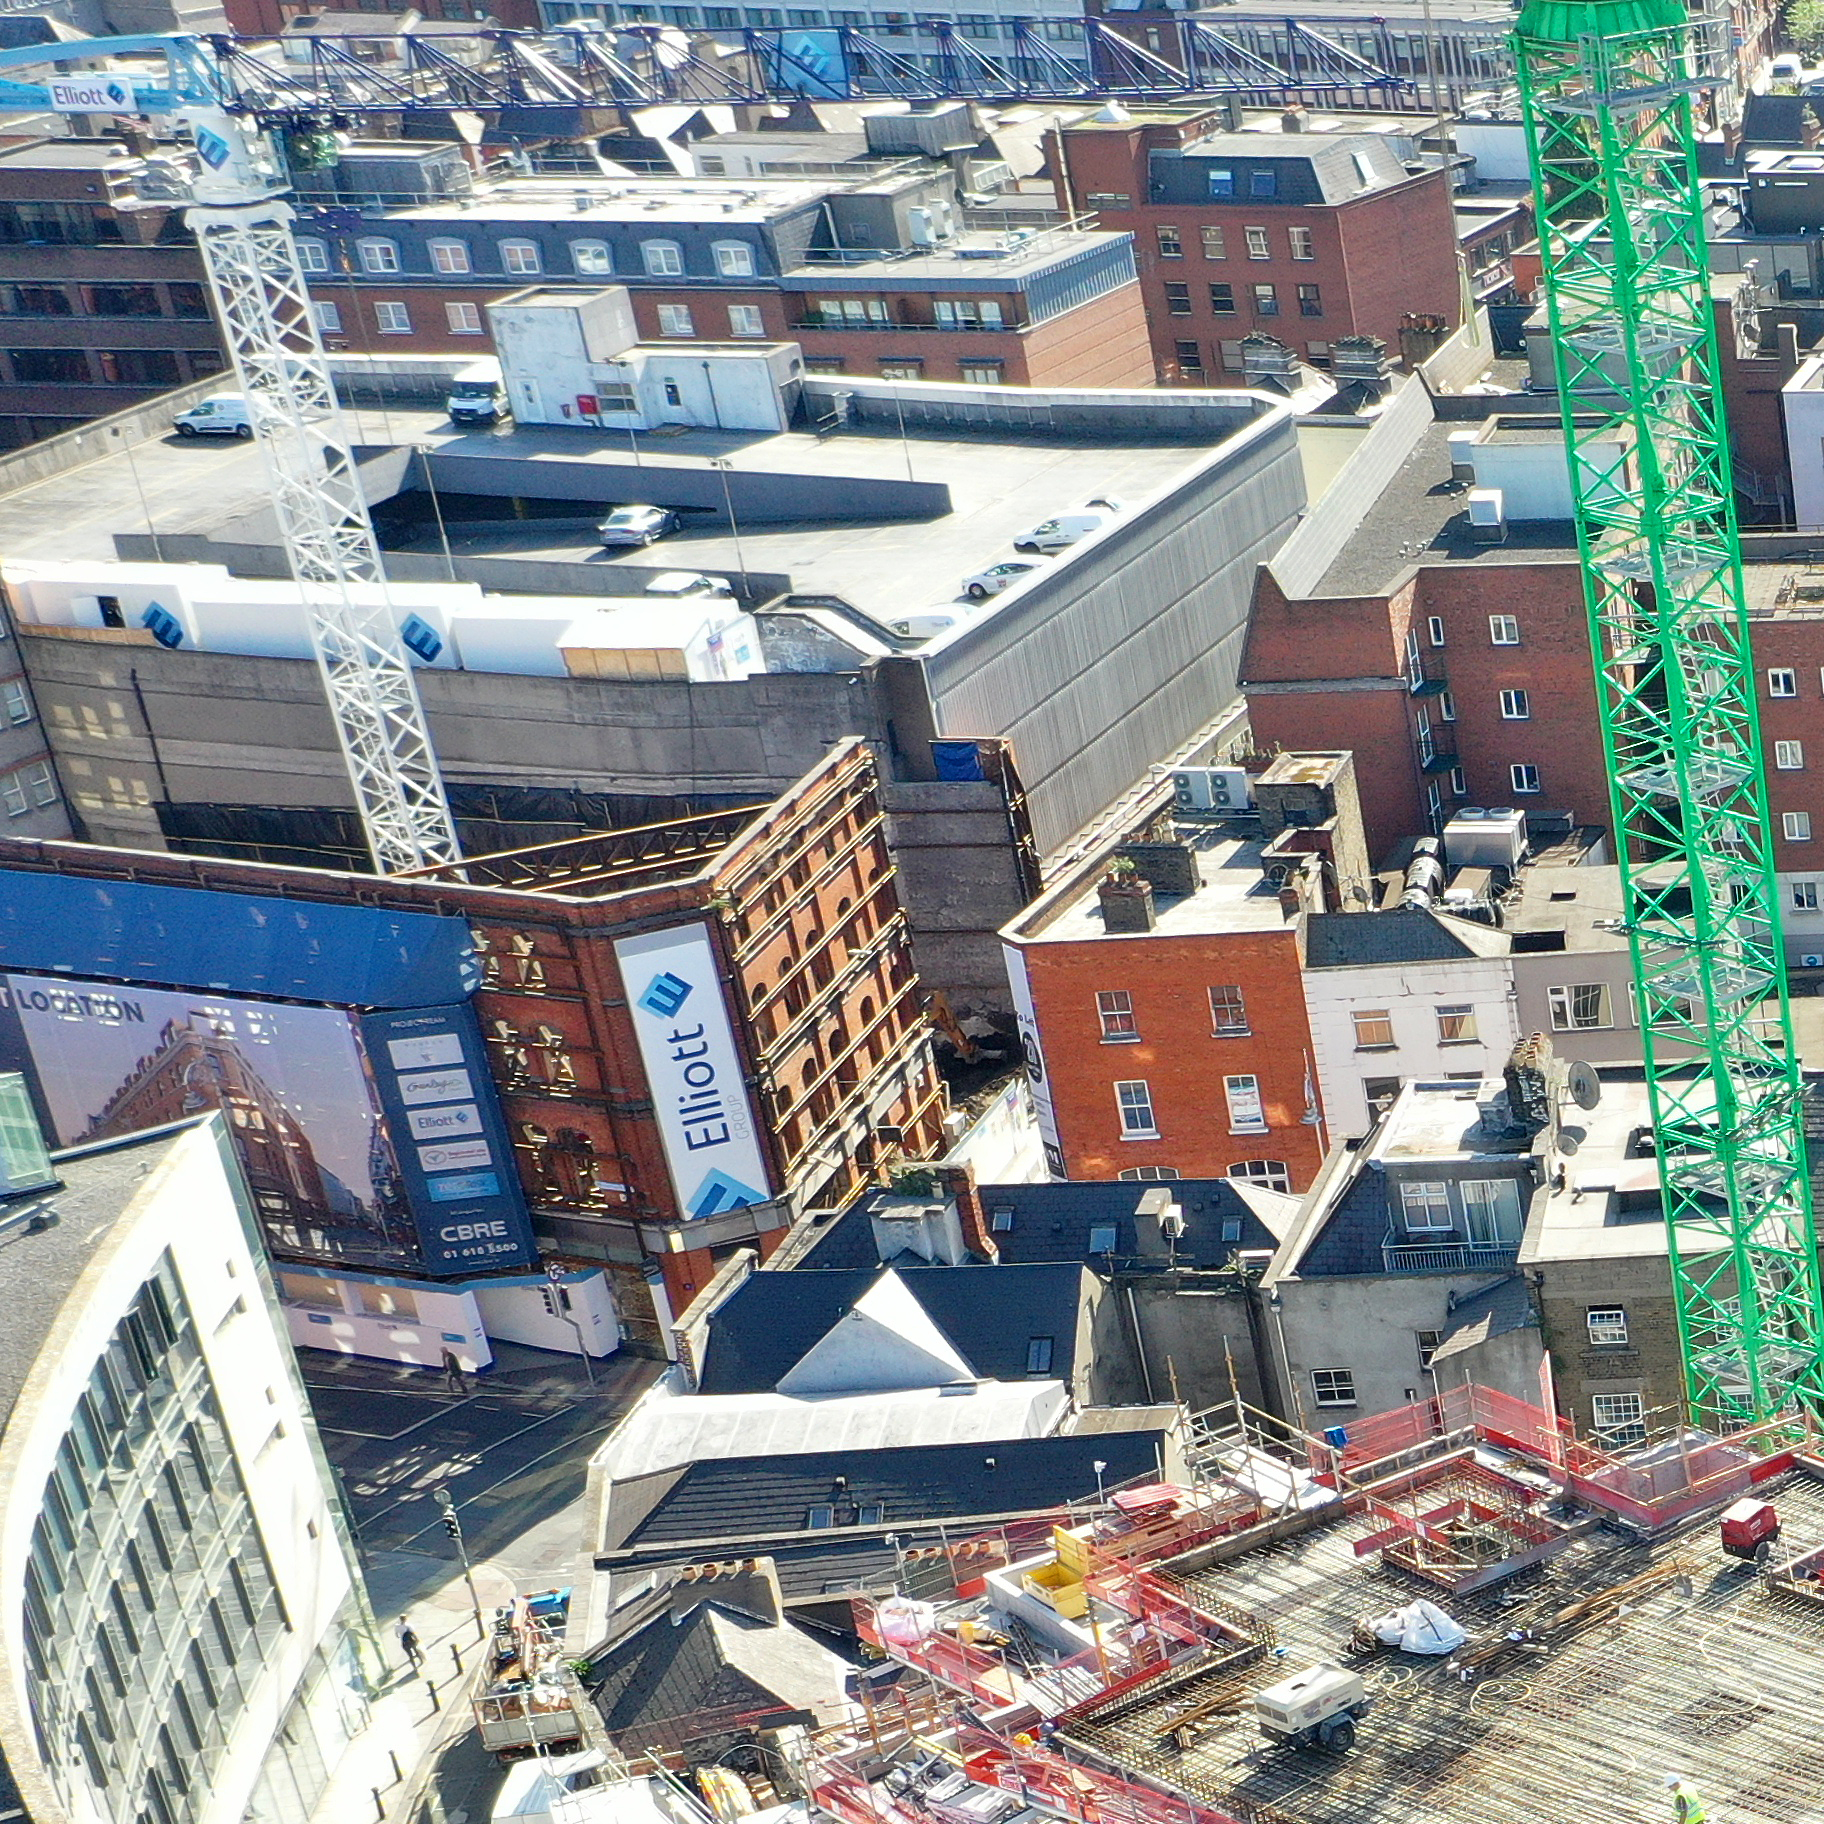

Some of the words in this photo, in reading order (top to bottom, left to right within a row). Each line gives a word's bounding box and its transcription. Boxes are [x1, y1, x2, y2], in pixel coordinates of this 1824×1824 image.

[52, 85, 106, 106] Elliott
[15, 989, 145, 1023] LOCATION
[667, 1022, 731, 1151] Elliott
[418, 1116, 454, 1129] Elliott
[727, 1094, 750, 1140] GROUP
[441, 1220, 508, 1242] CBRE
